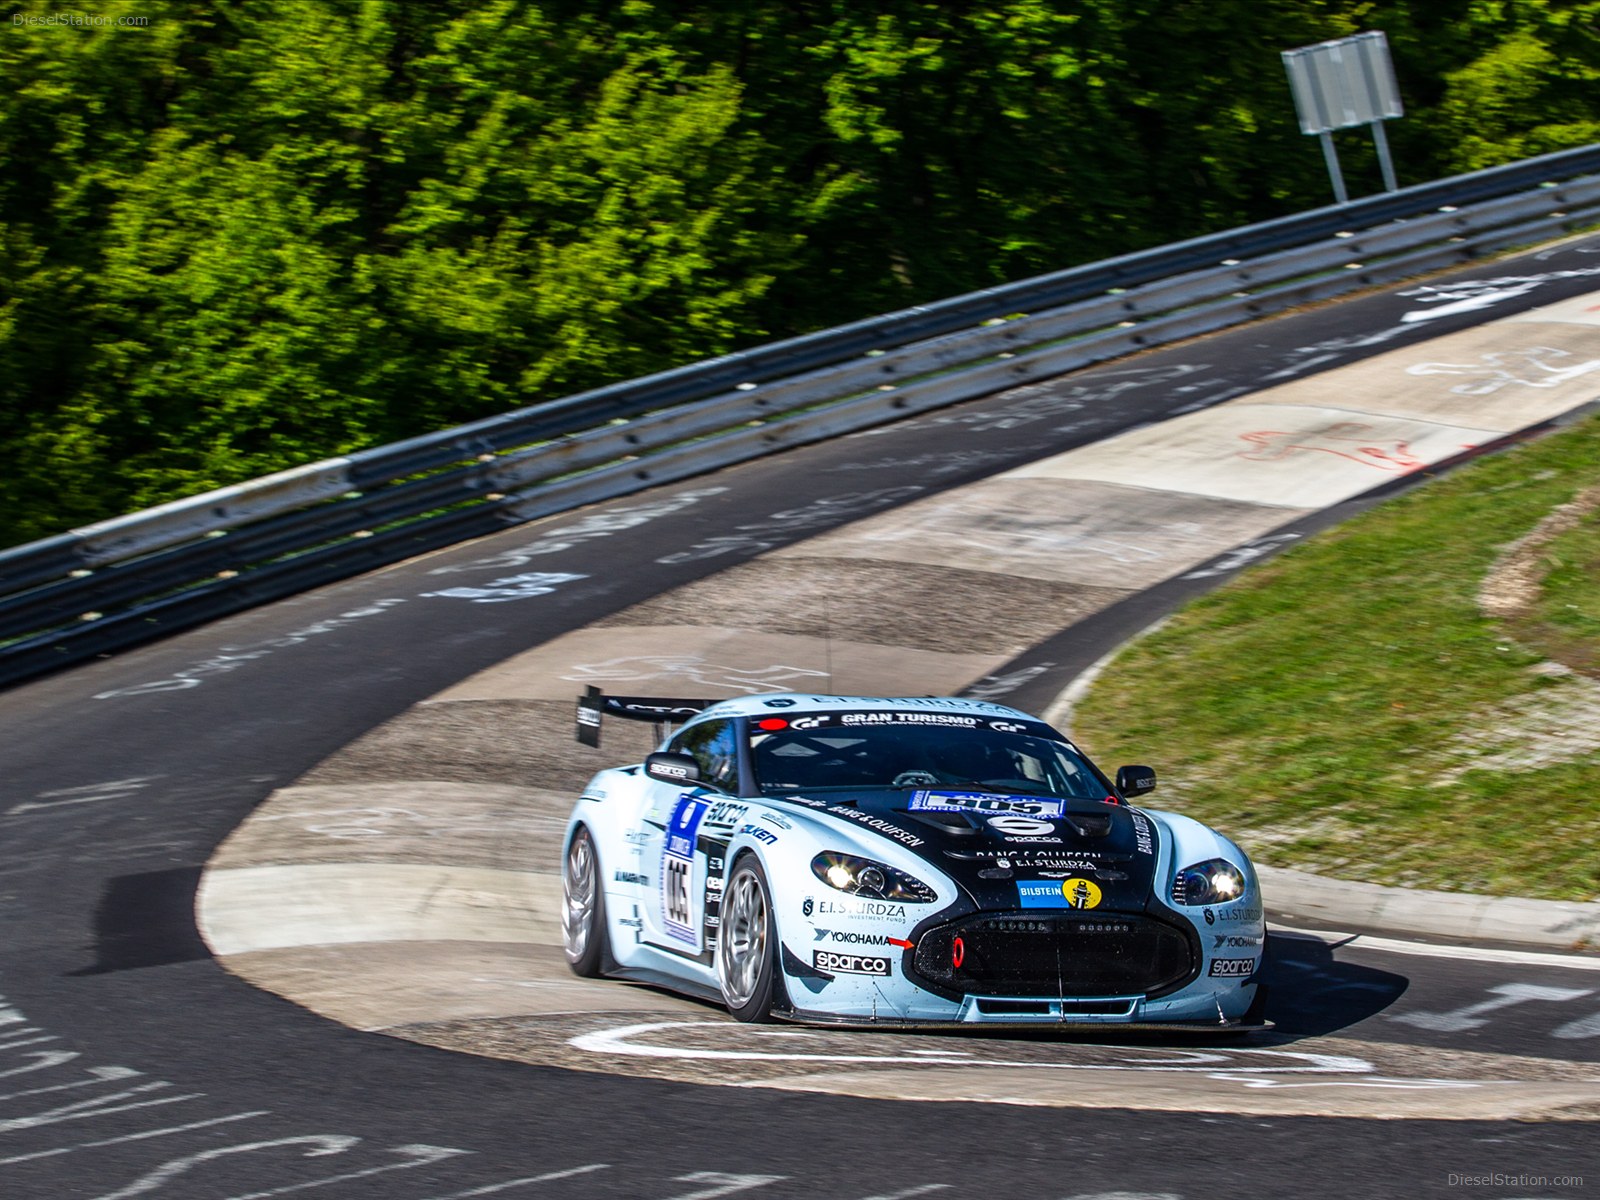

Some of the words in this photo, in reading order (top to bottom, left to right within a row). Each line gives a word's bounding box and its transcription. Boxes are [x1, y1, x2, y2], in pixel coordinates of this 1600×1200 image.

[841, 713, 893, 723] GRAN
[895, 713, 976, 725] TURISMO
[868, 819, 925, 847] OLUFSEN
[1020, 887, 1061, 896] BILSTEIN
[830, 931, 891, 946] YOKOHAMA
[816, 952, 887, 972] sparco
[1213, 960, 1254, 975] sparco
